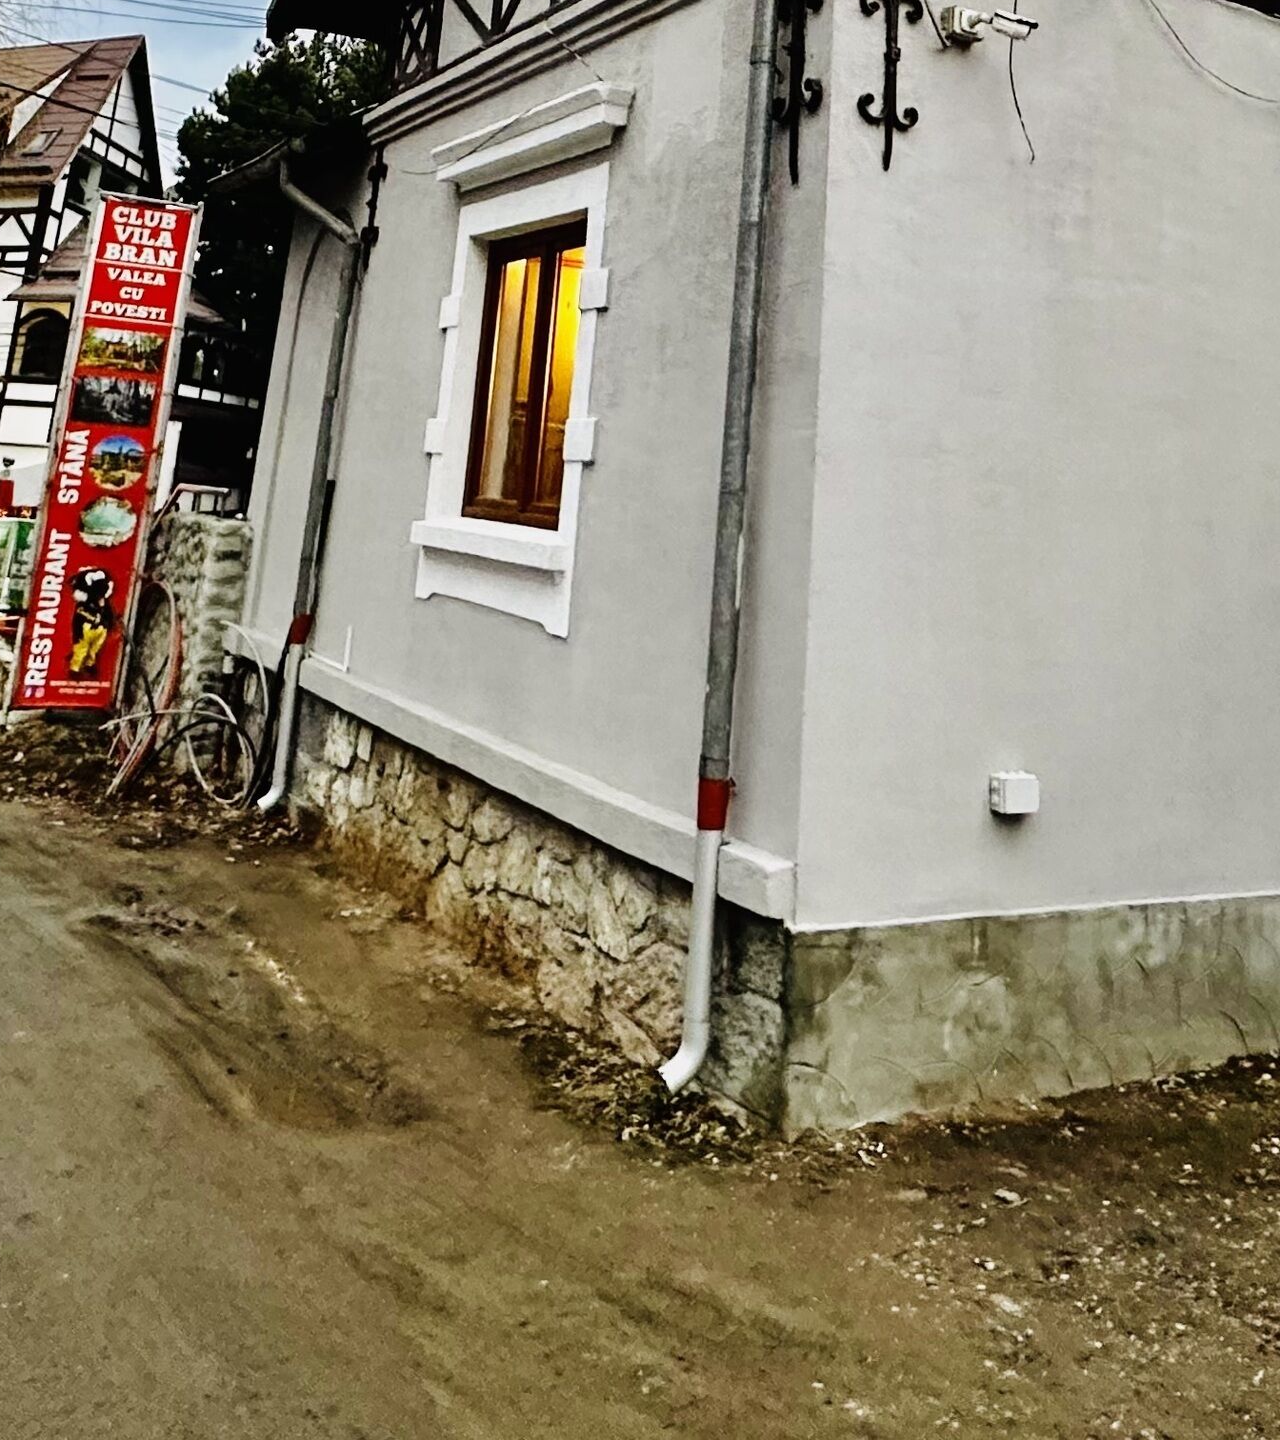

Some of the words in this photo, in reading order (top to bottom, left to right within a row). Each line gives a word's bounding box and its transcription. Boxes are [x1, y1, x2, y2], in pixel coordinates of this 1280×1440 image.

[112, 206, 177, 230] CLUB
[114, 224, 174, 248] VILA
[103, 242, 177, 267] BRAN
[107, 267, 166, 286] VALEA
[119, 286, 144, 300] CU
[90, 300, 167, 320] POVESTI
[24, 528, 72, 686] RESTAURANT
